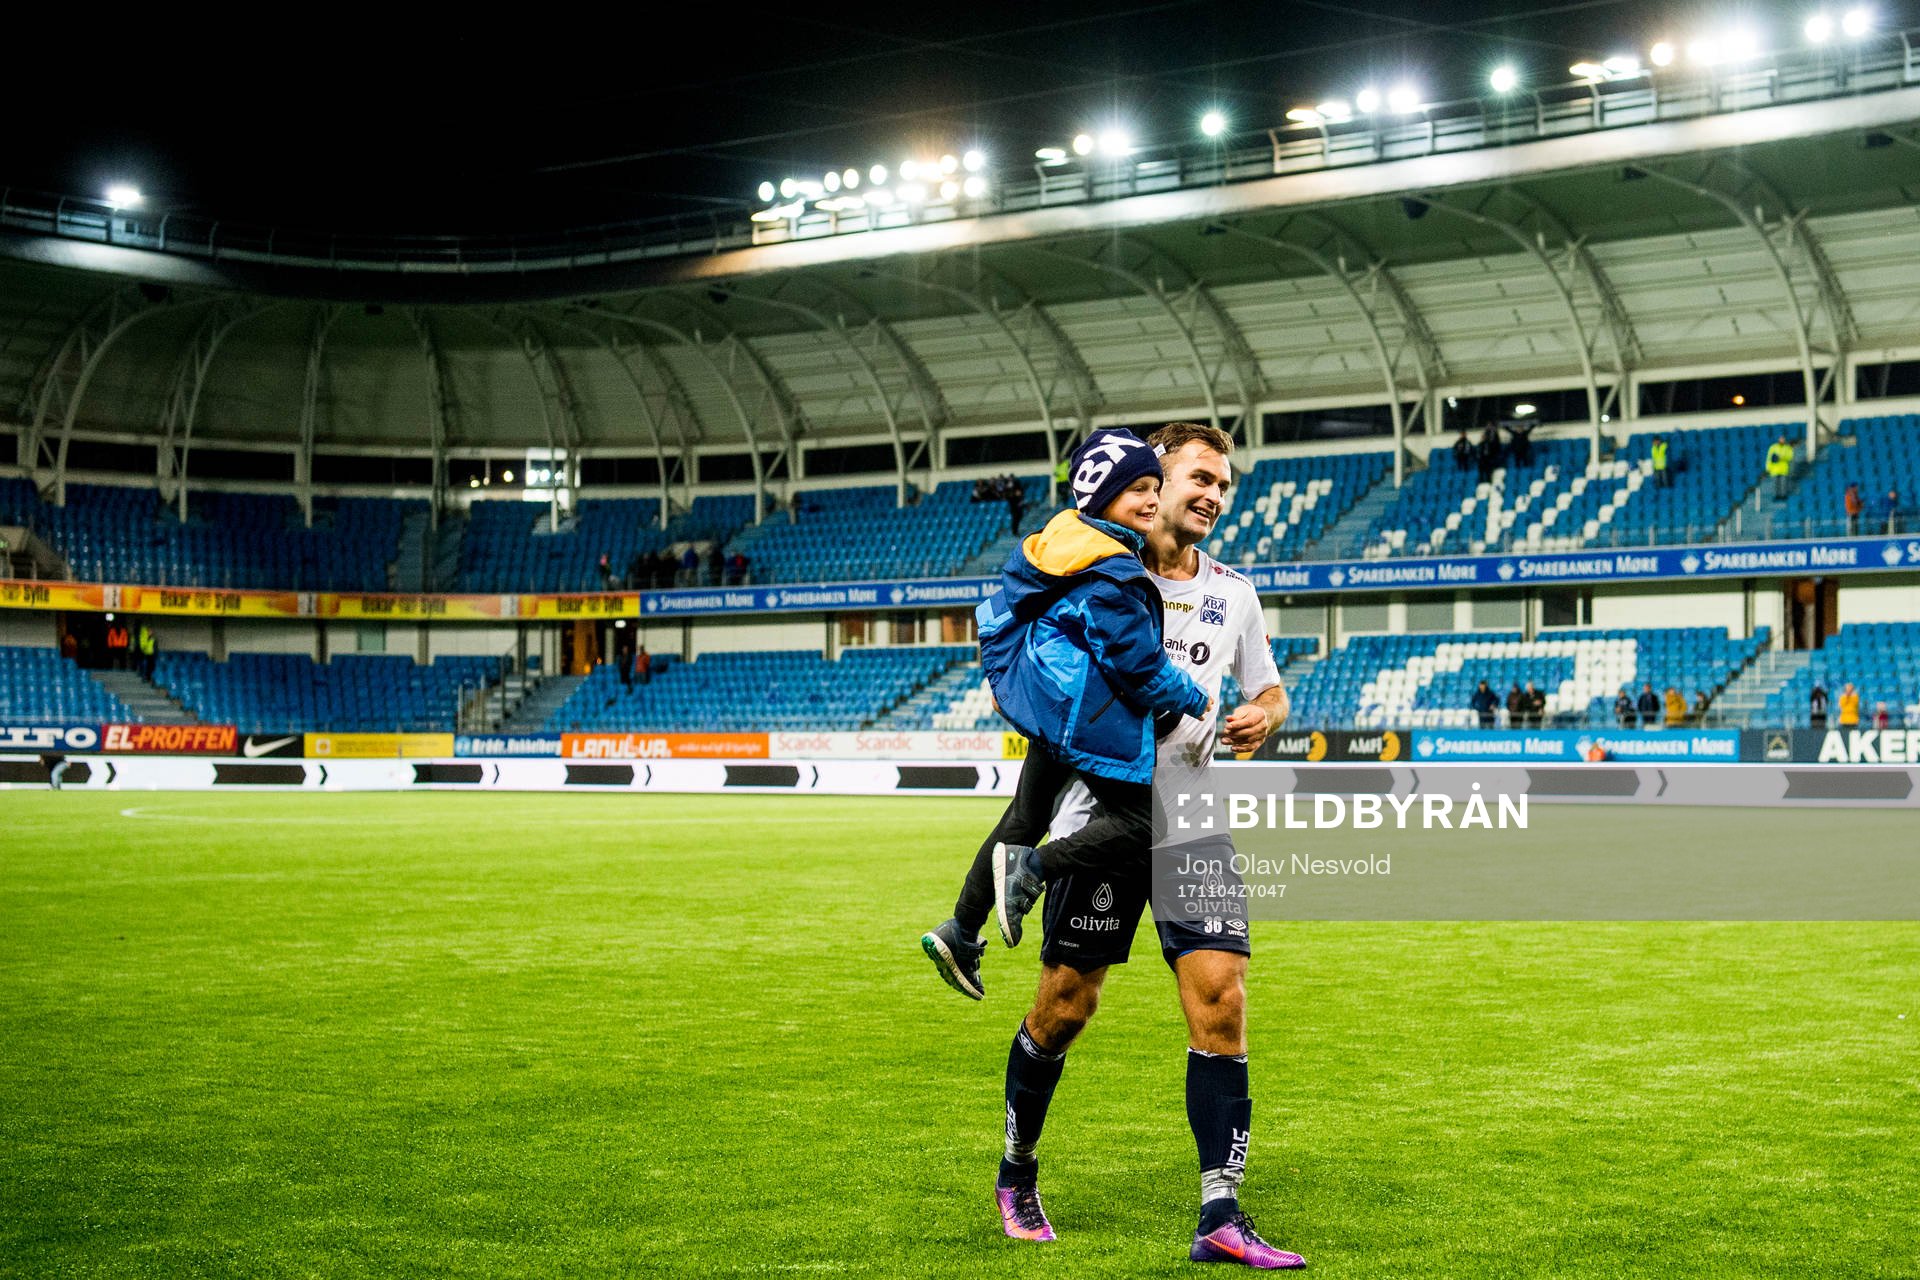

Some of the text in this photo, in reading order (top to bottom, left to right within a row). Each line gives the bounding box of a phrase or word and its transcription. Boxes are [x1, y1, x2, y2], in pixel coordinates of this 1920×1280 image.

[1162, 638, 1188, 652] ank
[778, 732, 832, 751] Scandic
[856, 732, 912, 751] Scandic
[936, 732, 993, 751] Scandic
[1185, 899, 1242, 915] olivita
[1070, 915, 1120, 931] olivita
[1204, 915, 1223, 934] 36
